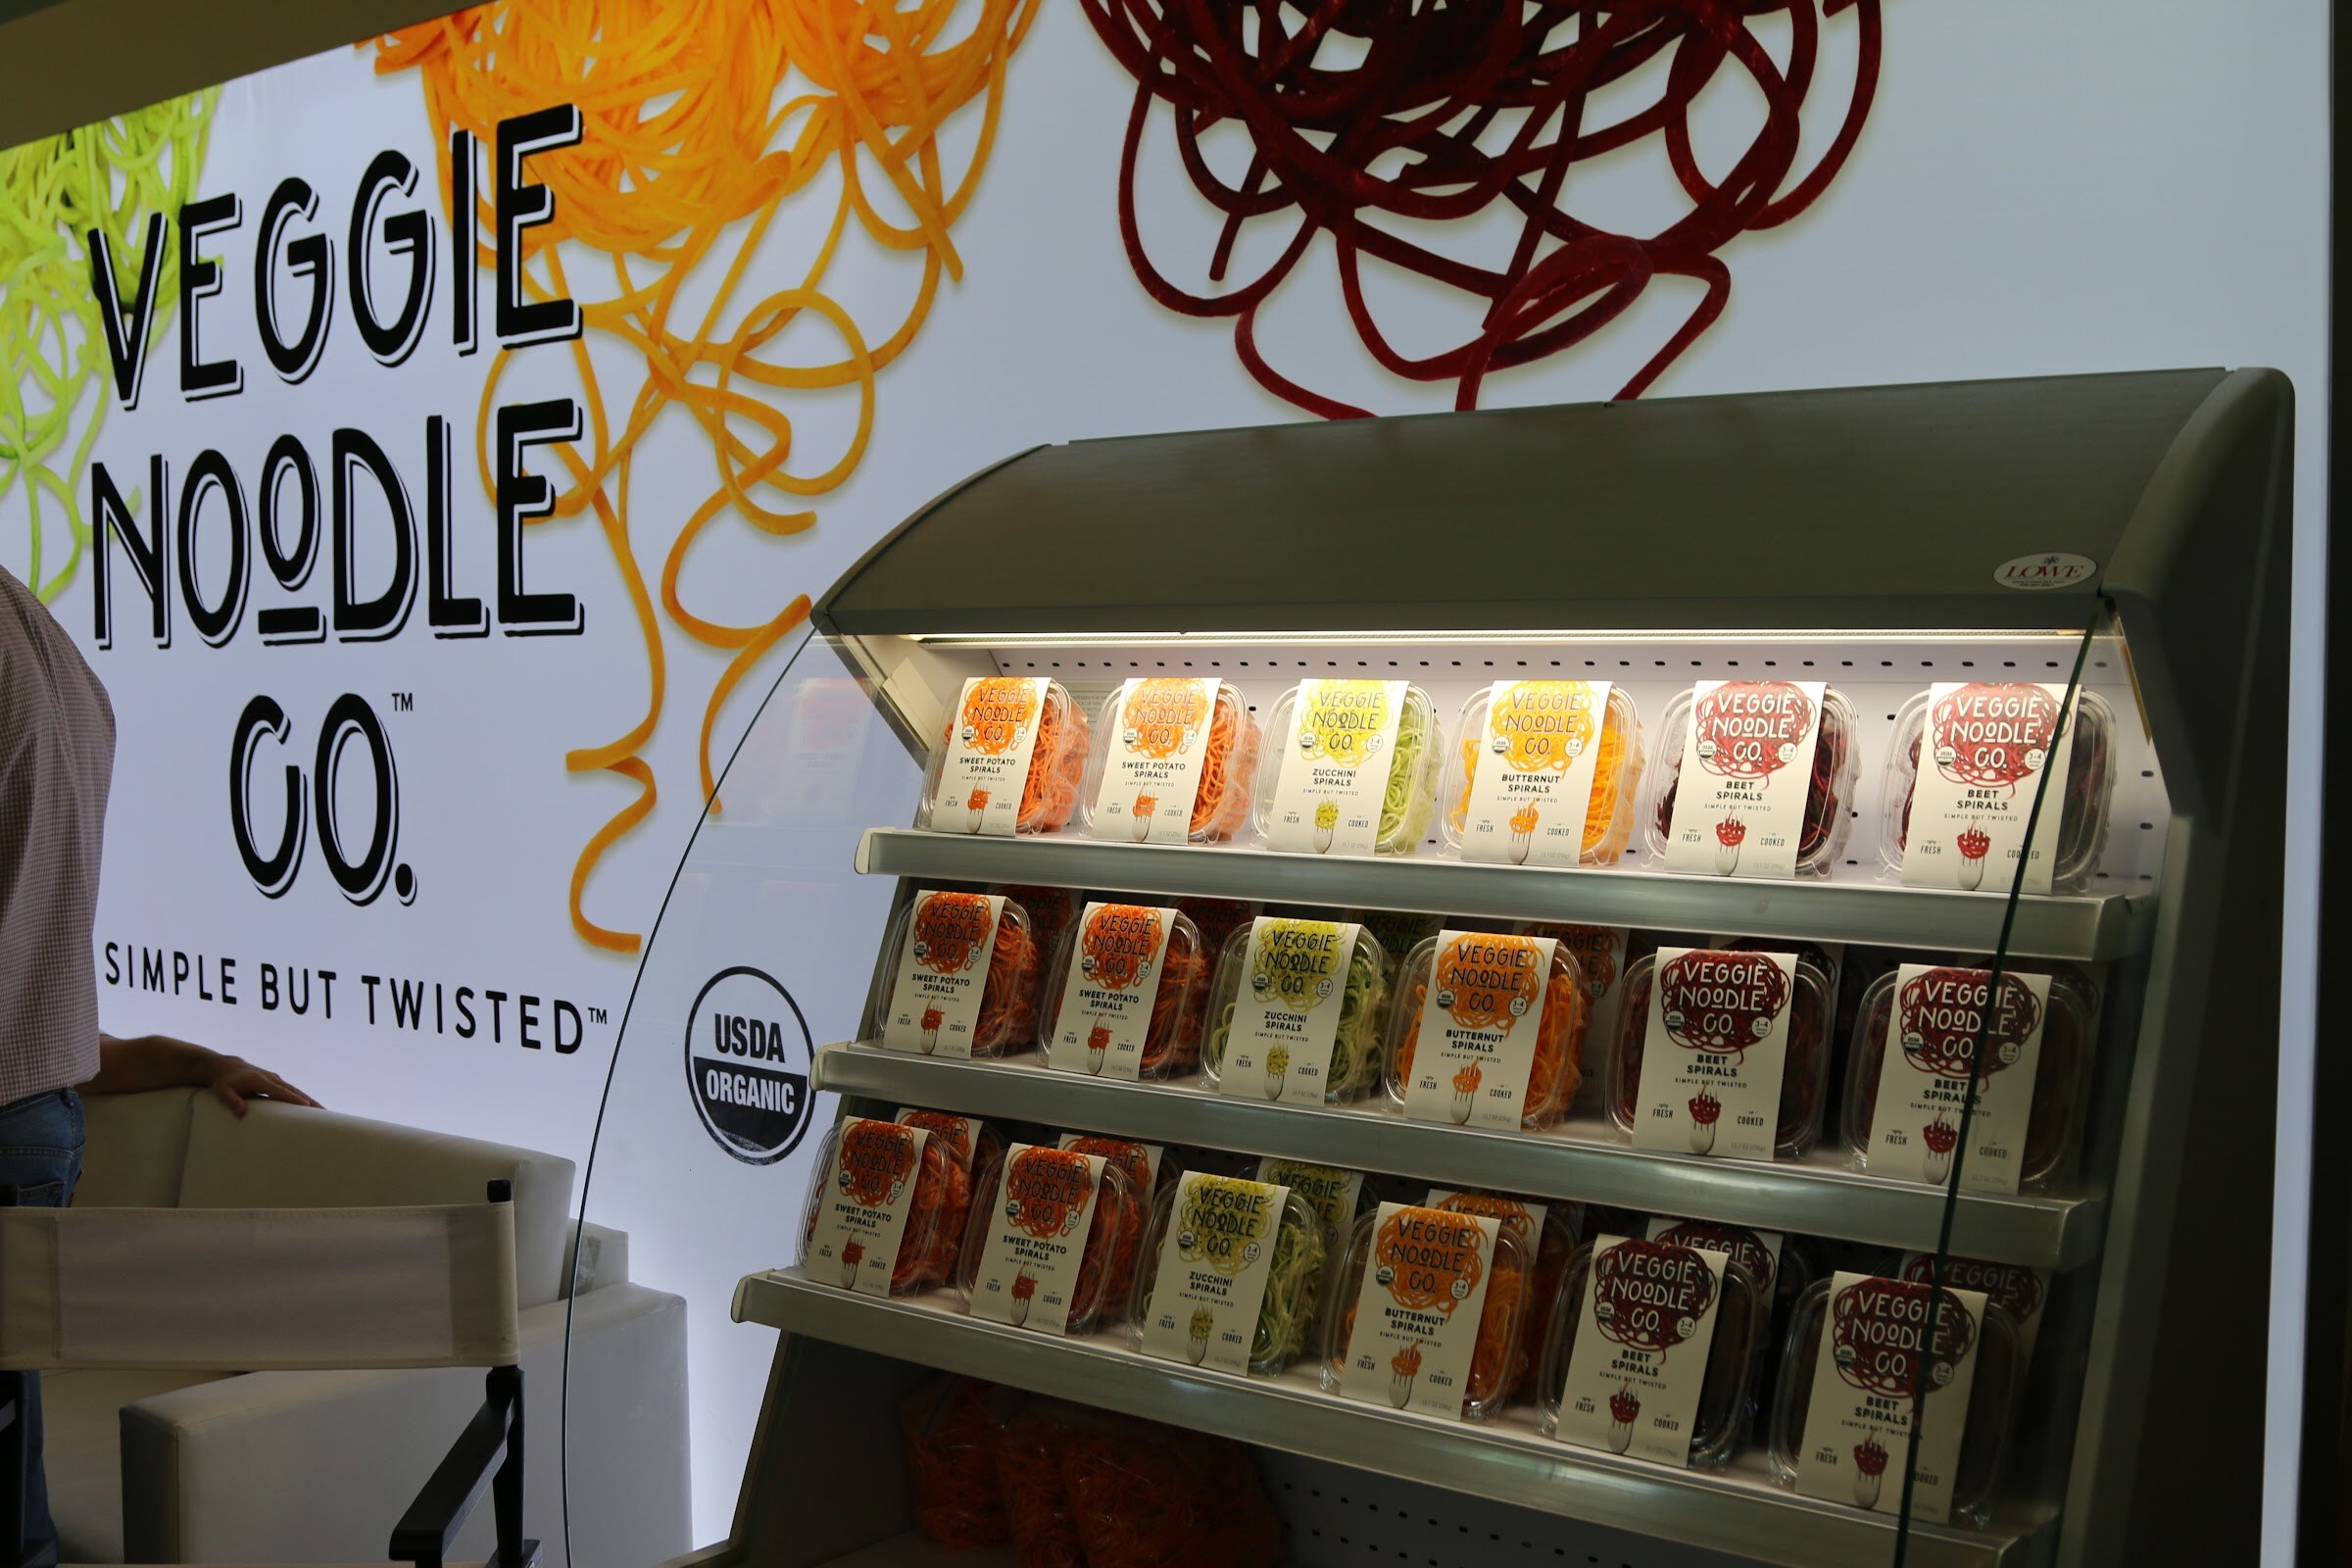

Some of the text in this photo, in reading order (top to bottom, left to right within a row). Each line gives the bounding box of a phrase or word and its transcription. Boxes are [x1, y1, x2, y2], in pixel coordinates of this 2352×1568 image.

[88, 103, 583, 410] VEGGIE
[91, 398, 584, 650] NOODLE
[2005, 565, 2083, 577] LOWE
[980, 688, 1029, 704] VEGGIE
[1142, 689, 1199, 705] VEGGIE
[1320, 692, 1384, 708] VEGGIE
[1513, 693, 1582, 710] VEGGIE
[1717, 693, 1795, 713] VEGGIE
[973, 707, 1025, 722] NOODLE
[1956, 696, 2043, 718] VEGGIE
[1135, 709, 1194, 724] NOODLE
[1312, 712, 1379, 730] NOODLE
[1506, 715, 1578, 733] NOODLE
[1712, 717, 1792, 739] NOODLE
[1950, 721, 2039, 744] NOODLE
[1312, 768, 1356, 777] ZUCCHINI
[1501, 774, 1560, 783] BUTTERNUT
[1508, 784, 1550, 793] SPIRALS
[1716, 792, 1763, 801] SPIRALS
[1968, 789, 1999, 798] BEET
[230, 693, 416, 906] CO.
[1957, 801, 2008, 810] SPIRALS
[1348, 819, 1368, 828] COOKED
[1761, 838, 1785, 847] COOKED
[1921, 846, 1941, 855] FRESH
[932, 903, 984, 922] VEGGIE
[925, 923, 980, 942] NOODLE
[1101, 914, 1155, 935] VEGGIE
[1094, 936, 1149, 956] NOODLE
[1273, 930, 1336, 952] VEGGIE
[1265, 952, 1331, 974] NOODLE
[1458, 944, 1528, 968] VEGGIE
[912, 974, 969, 986] SWEET POTATO
[1450, 968, 1523, 991] NOODLE
[1684, 961, 1768, 986] VEGGIE
[923, 984, 955, 993] SPIRALS
[1926, 980, 2017, 1008] VEGGIE
[105, 942, 237, 1004] SIMPLE
[261, 962, 337, 1018] BUT
[362, 975, 583, 1054] TWISTED
[1079, 990, 1139, 1004] SWEET POTATO
[1679, 986, 1764, 1011] NOODLE
[1091, 1001, 1123, 1010] SPIRALS
[1264, 1011, 1307, 1023] ZUCCHINI
[1265, 1022, 1301, 1032] SPIRALS
[714, 1013, 785, 1062] USDA
[1446, 1029, 1504, 1042] BUTTERNUT
[1452, 1041, 1494, 1053] SPIRALS
[1236, 1059, 1251, 1068] FRESH
[1697, 1054, 1728, 1064] BEET
[1298, 1067, 1318, 1076] COOKED
[1687, 1065, 1738, 1077] SPIRALS
[707, 1069, 794, 1114] ORGANIC
[1420, 1080, 1437, 1090] FRESH
[1935, 1079, 1968, 1091] BEET
[1490, 1089, 1512, 1099] COOKED
[1653, 1108, 1673, 1118] FRESH
[1738, 1116, 1764, 1126] COOKED
[858, 1130, 907, 1154] VEGGIE
[1886, 1135, 1907, 1145] FRESH
[1979, 1147, 2007, 1158] COOKED
[852, 1152, 904, 1176] NOODLE
[1026, 1158, 1083, 1183] VEGGIE
[1019, 1181, 1078, 1205] NOODLE
[1200, 1187, 1266, 1214] VEGGIE
[835, 1203, 892, 1222] SWEET POTATO
[846, 1215, 876, 1228] SPIRALS
[1192, 1209, 1258, 1237] NOODLE
[1397, 1218, 1470, 1249] VEGGIE
[1003, 1235, 1066, 1254] SWEET POTATO
[1014, 1247, 1050, 1260] SPIRALS
[1391, 1243, 1466, 1273] NOODLE
[1619, 1250, 1697, 1285] VEGGIE
[986, 1282, 1001, 1292] FRESH
[1189, 1272, 1233, 1288] ZUCCHINI
[1190, 1282, 1227, 1296] SPIRALS
[1611, 1278, 1694, 1310] NOODLE
[1044, 1295, 1061, 1305] COOKED
[1385, 1307, 1446, 1326] BUTTERNUT
[1859, 1291, 1952, 1327] VEGGIE
[1158, 1319, 1174, 1330] FRESH
[1392, 1320, 1434, 1336] SPIRALS
[1222, 1333, 1243, 1345] COOKED
[1851, 1318, 1949, 1355] NOODLE
[1622, 1349, 1651, 1363] BEET
[1357, 1359, 1375, 1371] FRESH
[1612, 1360, 1658, 1377] SPIRALS
[1430, 1373, 1452, 1387] COOKED
[1576, 1401, 1595, 1413] FRESH
[1866, 1396, 1899, 1411] BEET
[1855, 1407, 1908, 1426] SPIRALS
[1654, 1418, 1679, 1432] COOKED
[1816, 1450, 1838, 1465] FRESH
